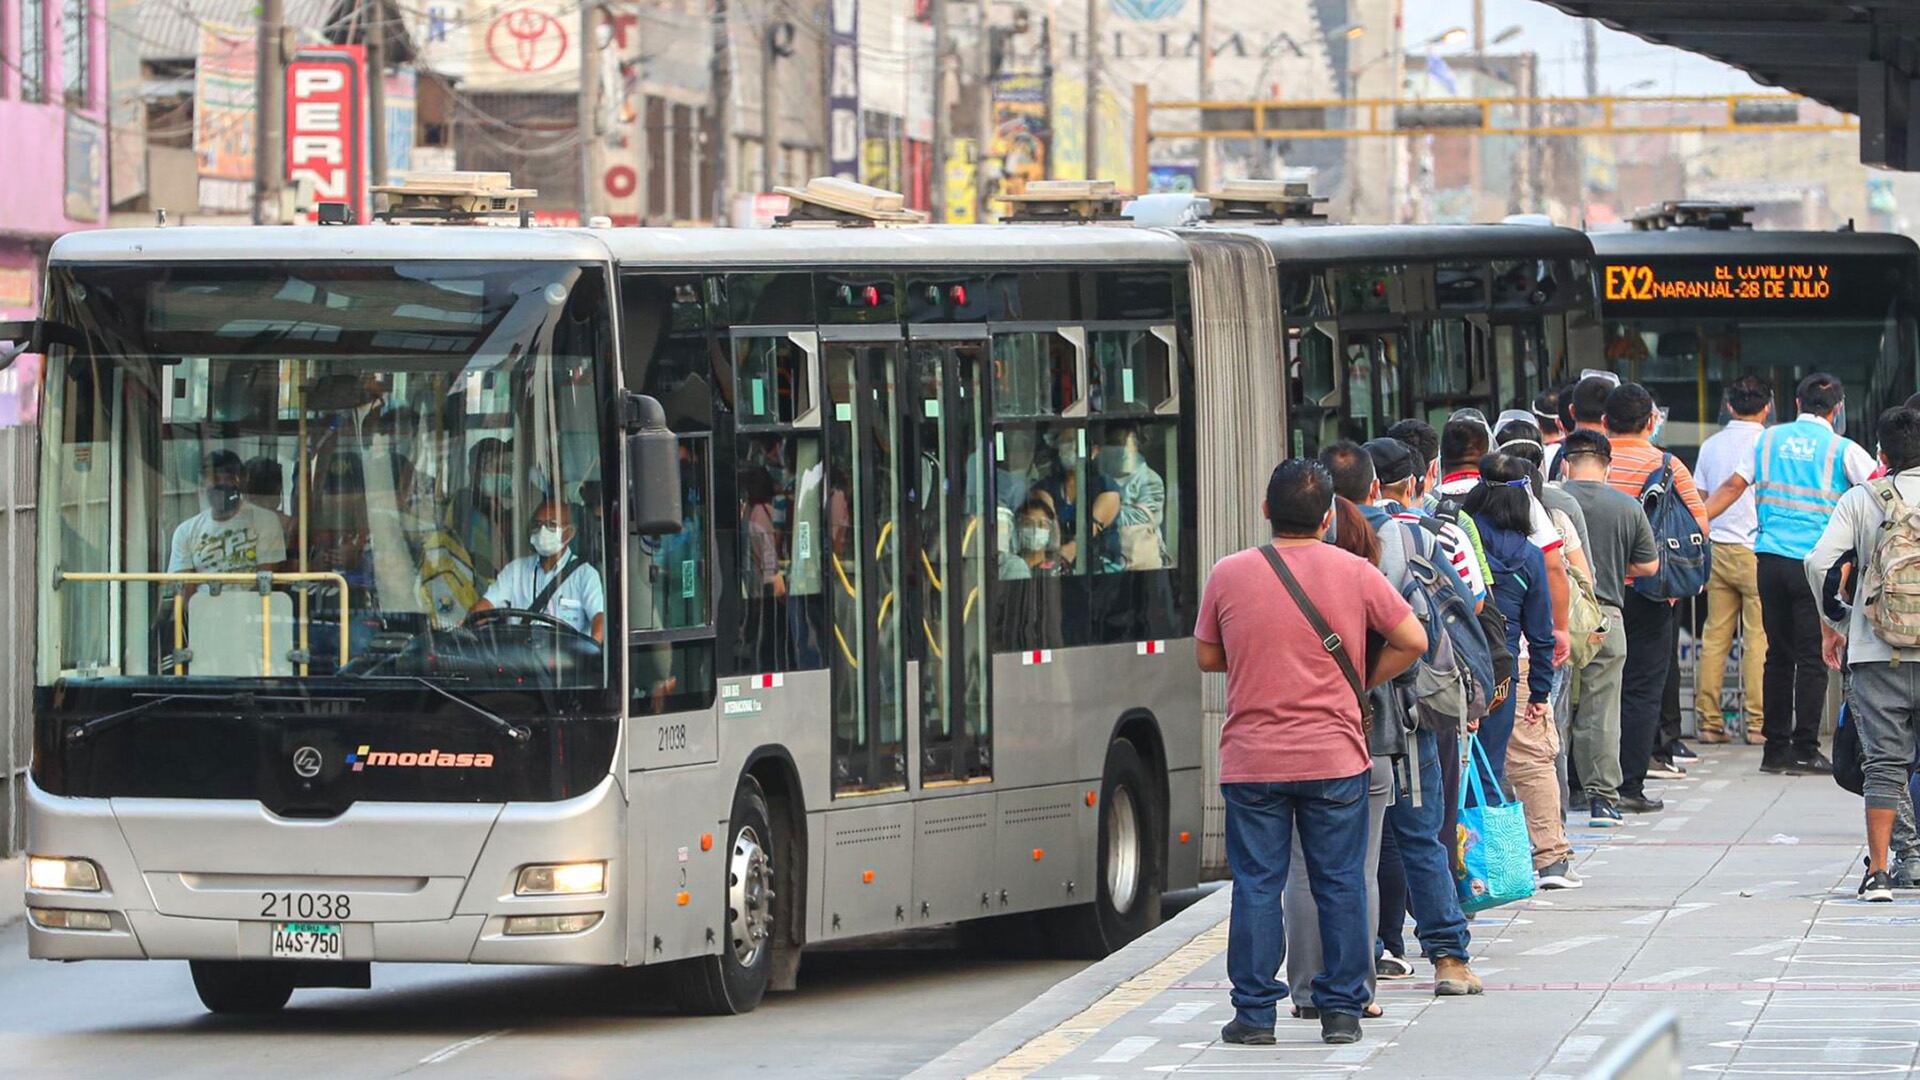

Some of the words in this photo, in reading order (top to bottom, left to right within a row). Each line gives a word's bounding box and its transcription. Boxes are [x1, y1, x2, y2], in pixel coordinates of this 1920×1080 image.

[1605, 265, 1654, 300] EX2
[1764, 280, 1785, 298] DE
[1789, 280, 1830, 298] JULIO
[658, 724, 687, 751] 21038
[366, 749, 494, 767] modasa
[261, 892, 351, 919] 21038
[275, 931, 339, 953] A4S-750
